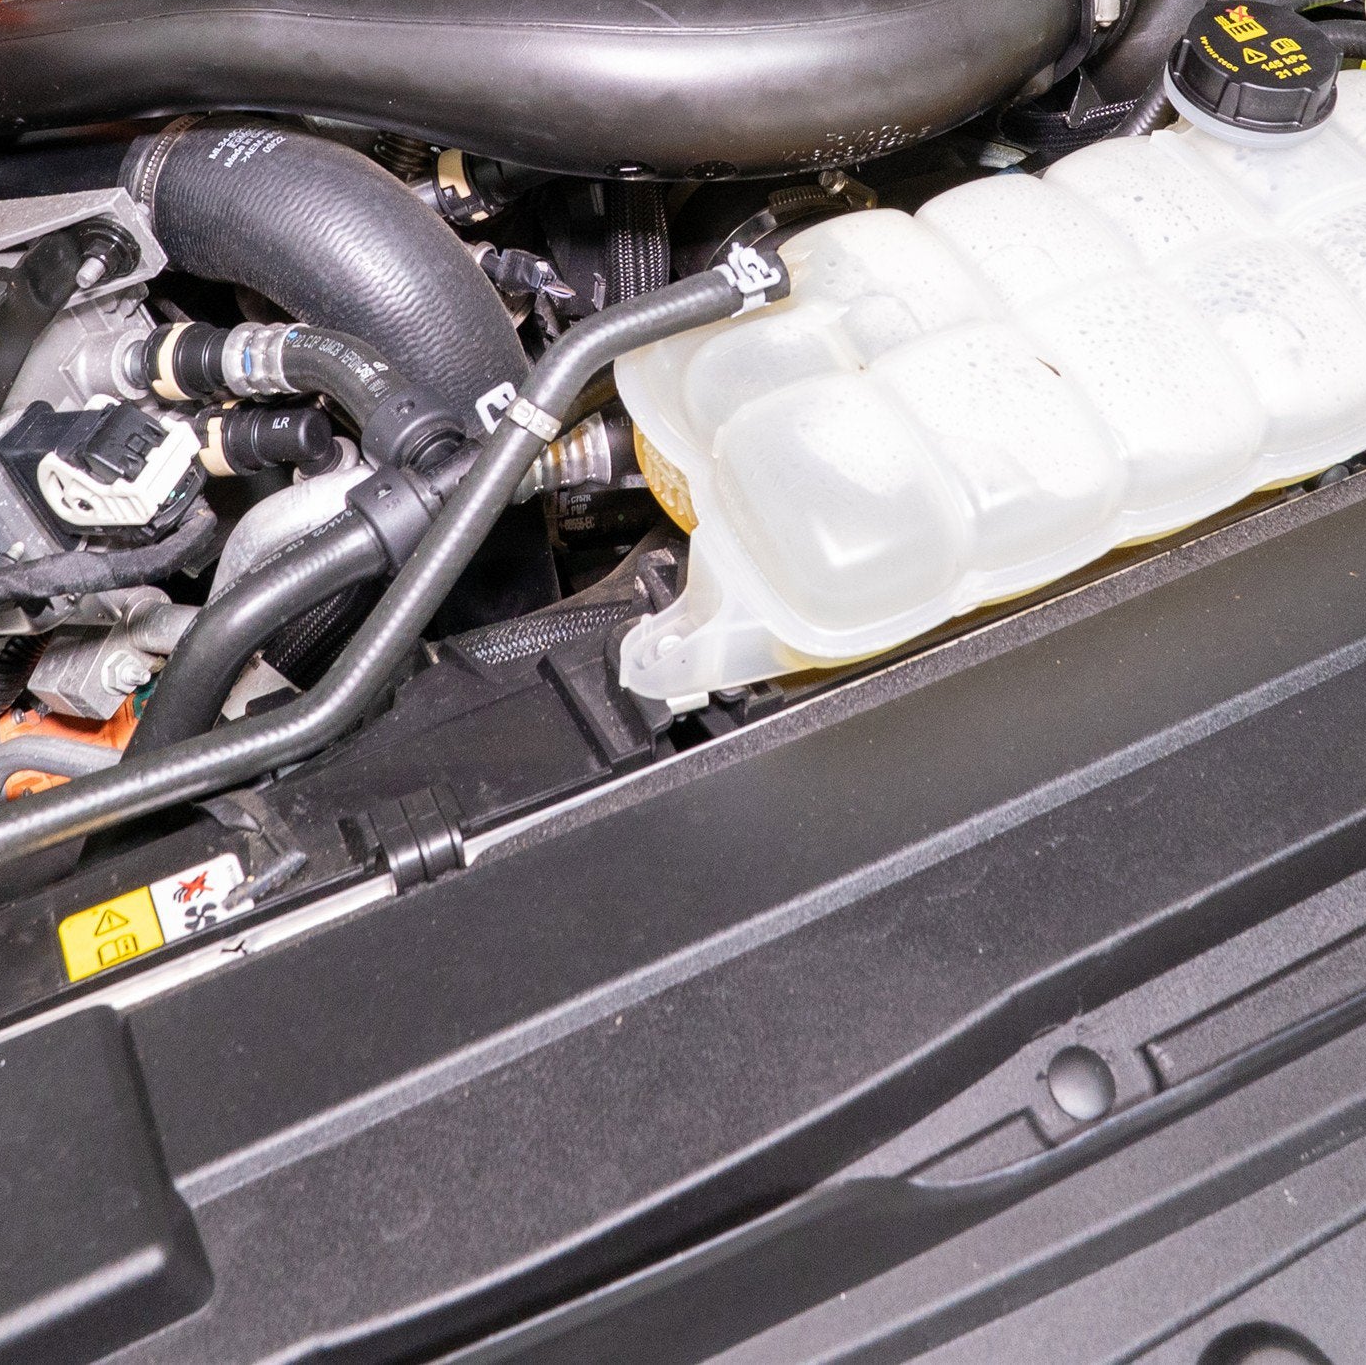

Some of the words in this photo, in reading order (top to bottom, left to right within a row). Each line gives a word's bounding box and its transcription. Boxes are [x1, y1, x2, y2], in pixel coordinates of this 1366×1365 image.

[1261, 59, 1284, 71] 145
[1282, 54, 1307, 65] kPa
[1275, 69, 1292, 79] 21
[1292, 63, 1311, 75] psi
